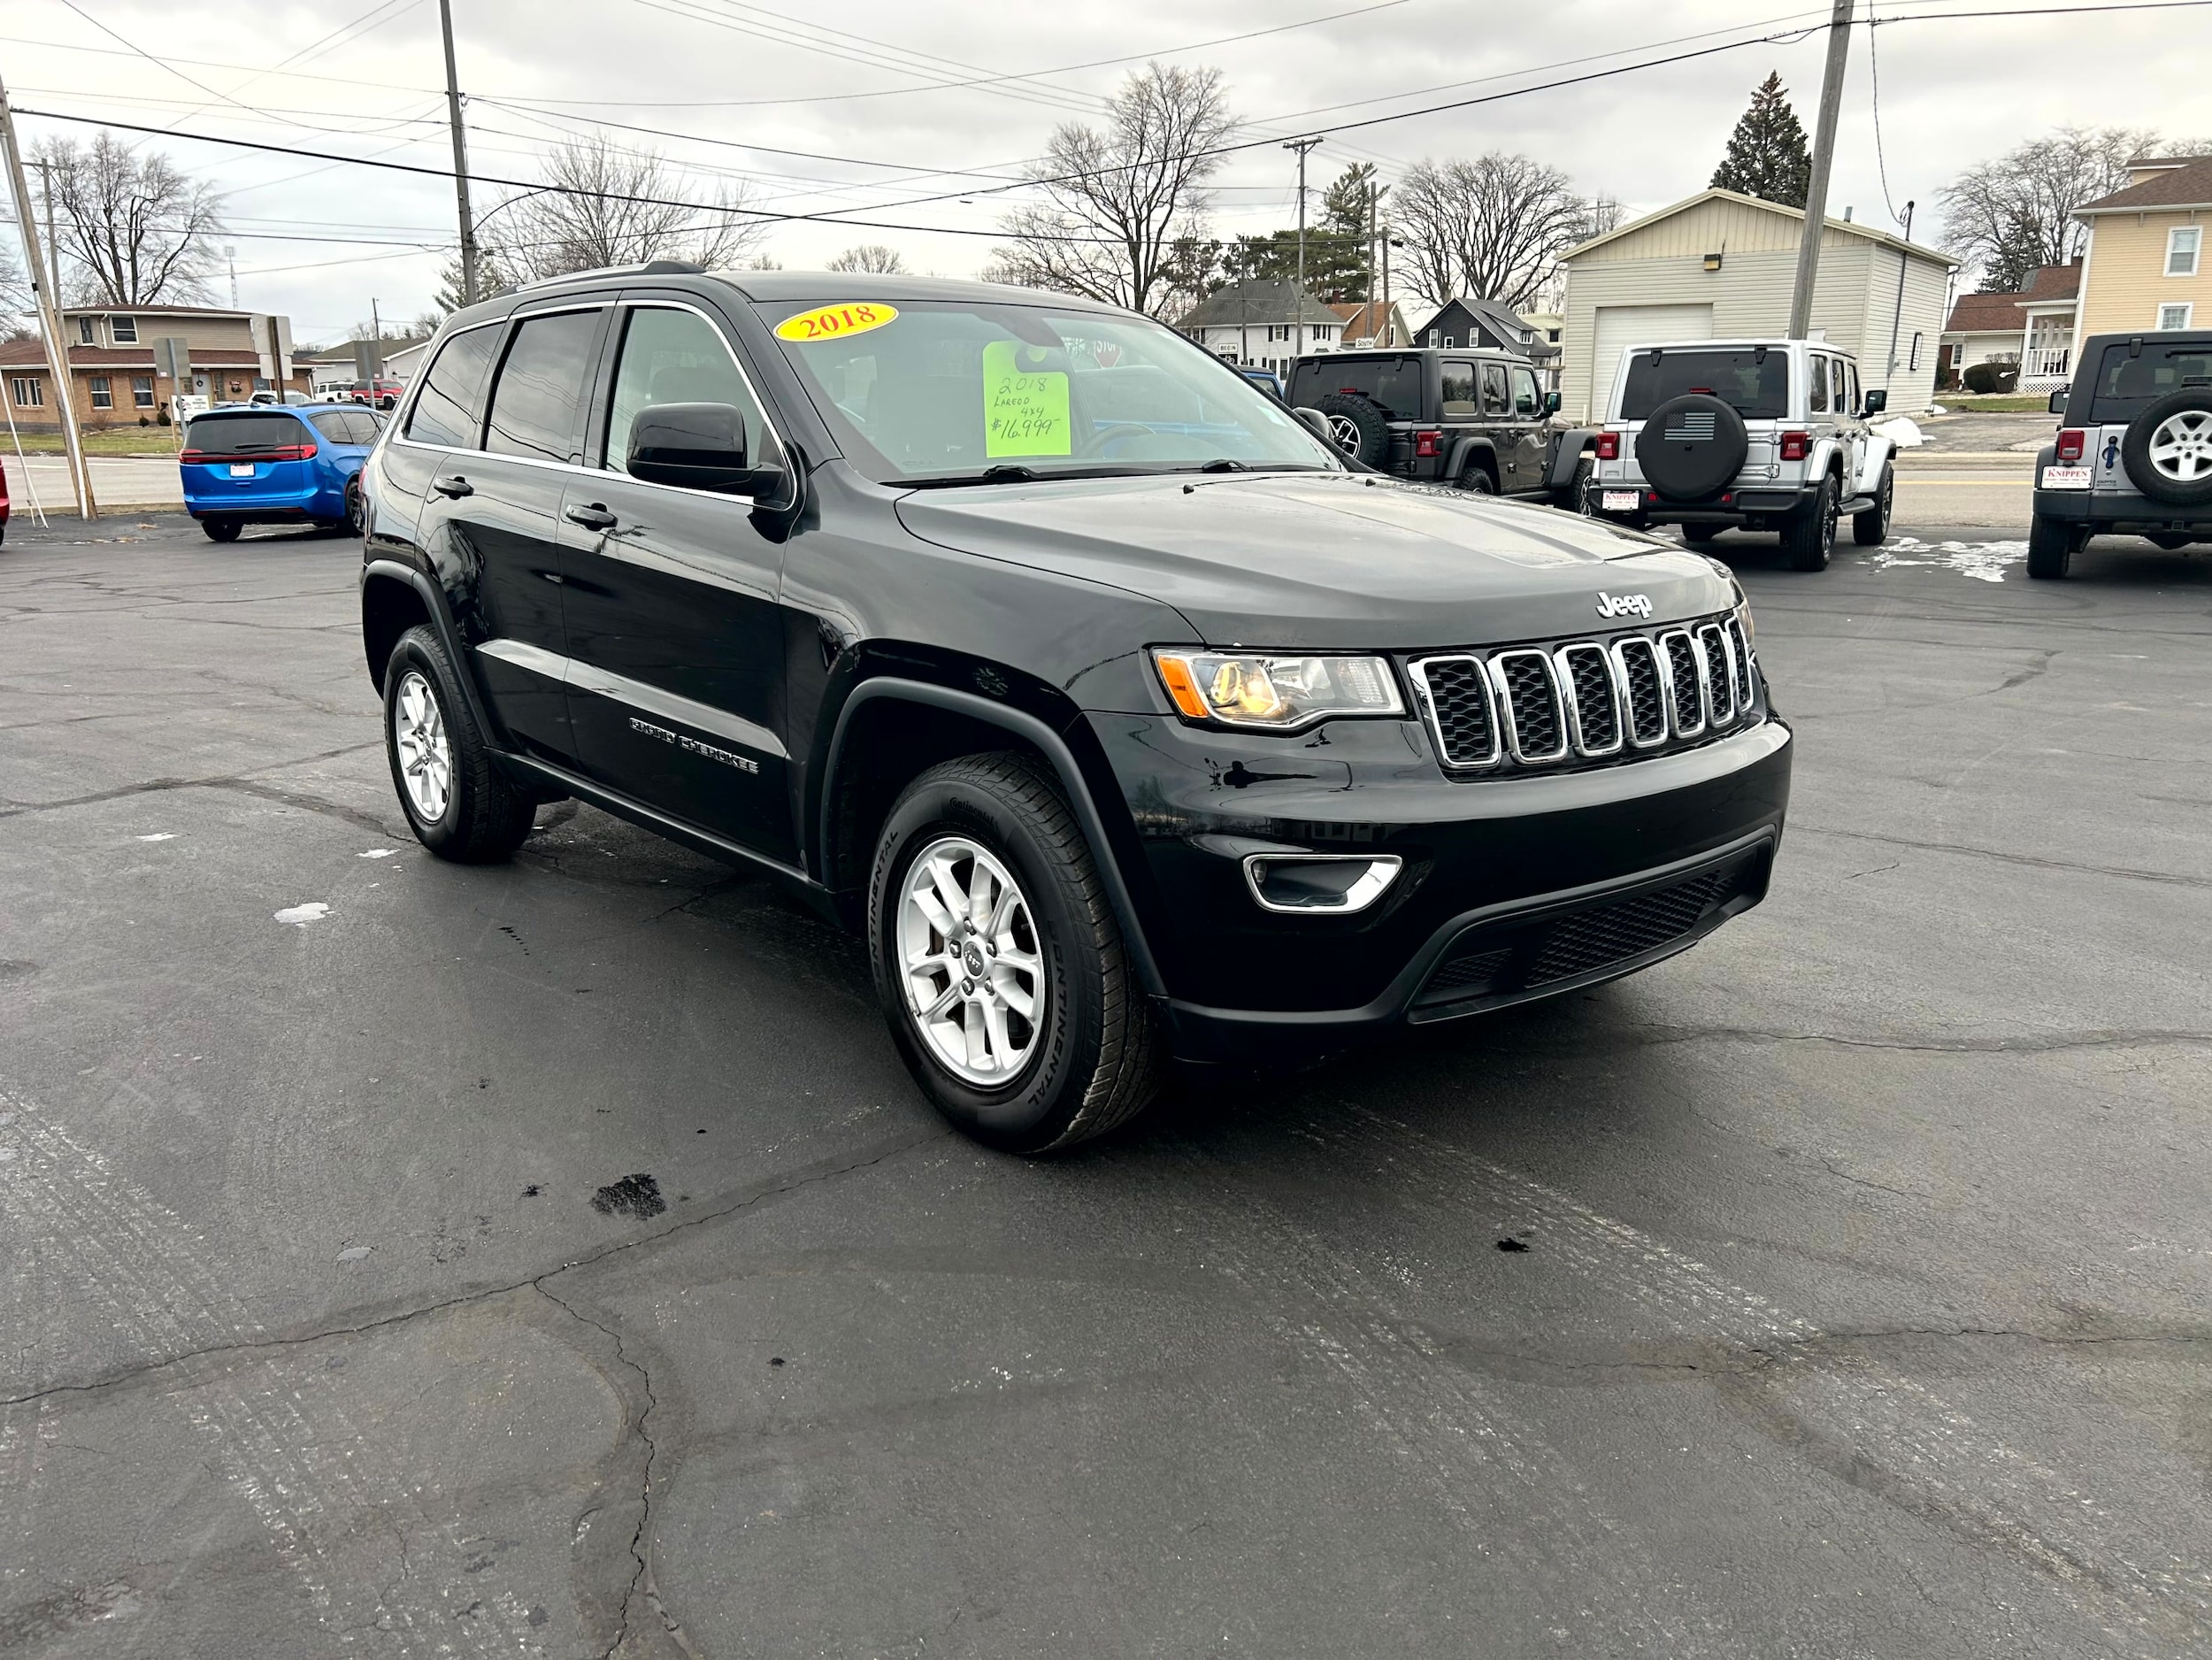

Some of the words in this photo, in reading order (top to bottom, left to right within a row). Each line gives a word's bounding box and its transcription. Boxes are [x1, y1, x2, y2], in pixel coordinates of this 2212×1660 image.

[800, 305, 876, 338] 2018
[998, 377, 1048, 395] 2018
[2047, 468, 2088, 477] KNIPPEN
[1595, 591, 1653, 619] Jeep
[629, 717, 677, 743] GRAND
[679, 735, 759, 774] CHEROKEE
[949, 796, 995, 822] Continental
